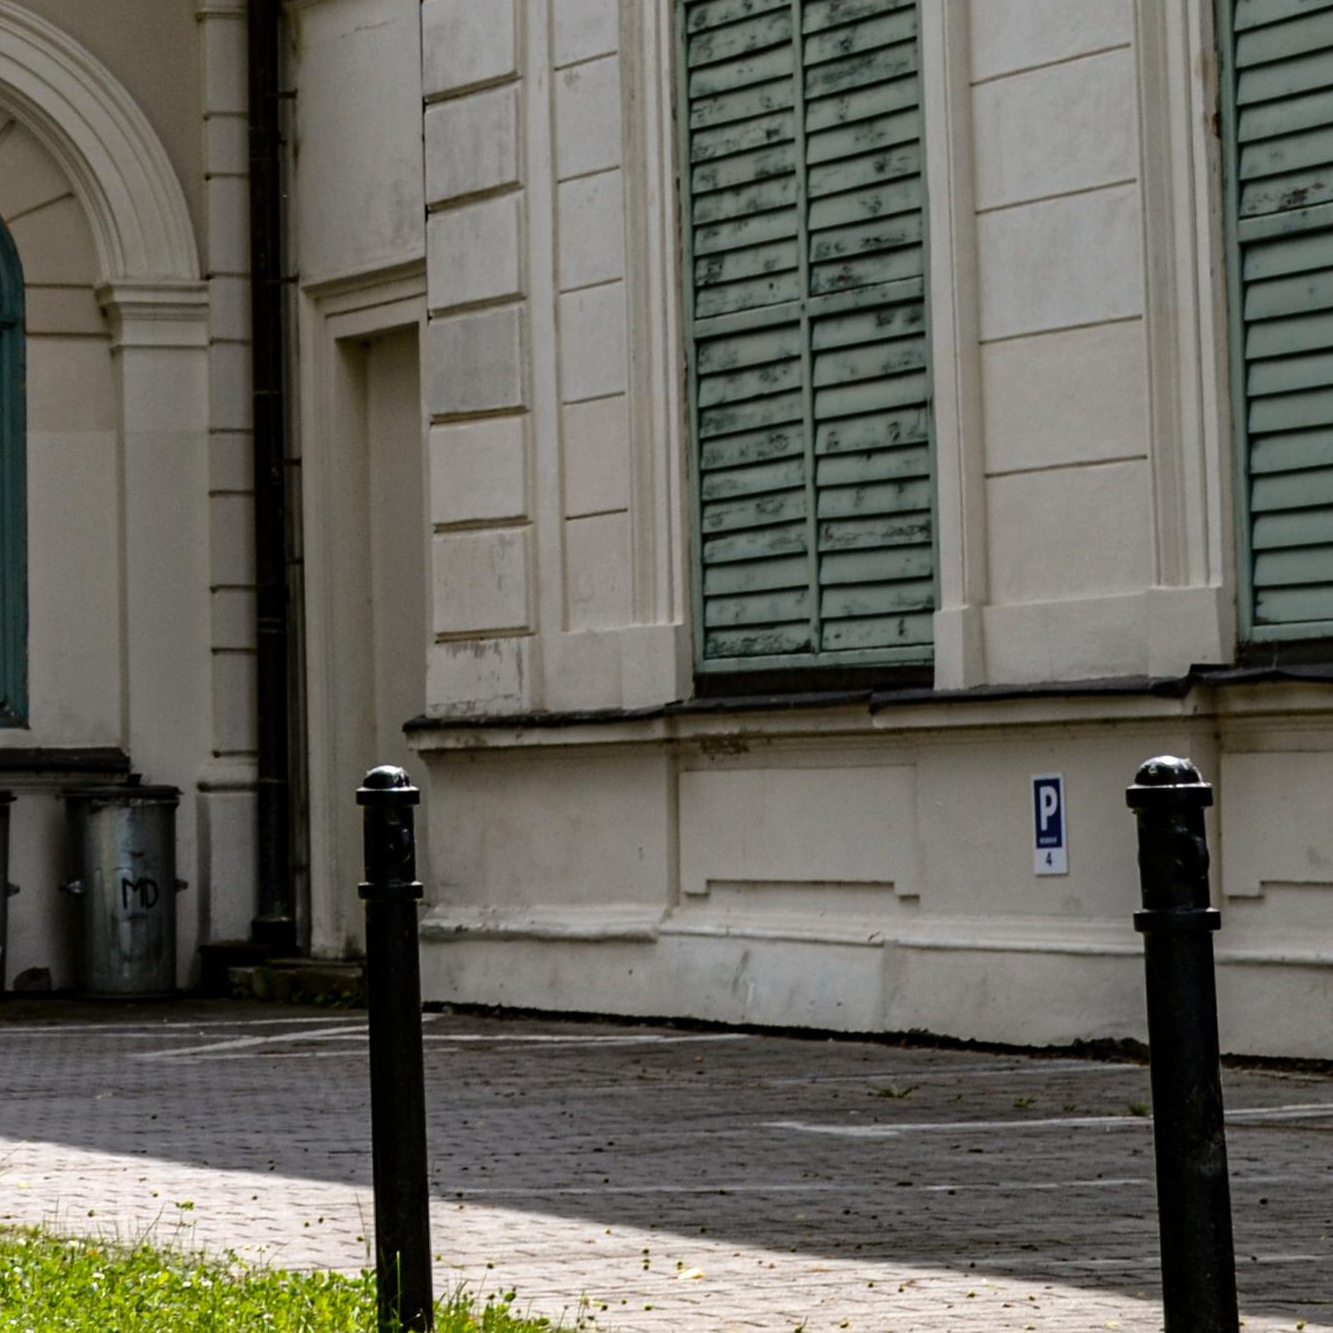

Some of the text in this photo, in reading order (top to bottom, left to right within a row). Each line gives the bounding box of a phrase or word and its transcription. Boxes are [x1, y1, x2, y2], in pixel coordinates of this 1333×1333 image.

[1039, 785, 1058, 831] P
[1045, 851, 1052, 867] 4
[121, 877, 159, 910] MD
